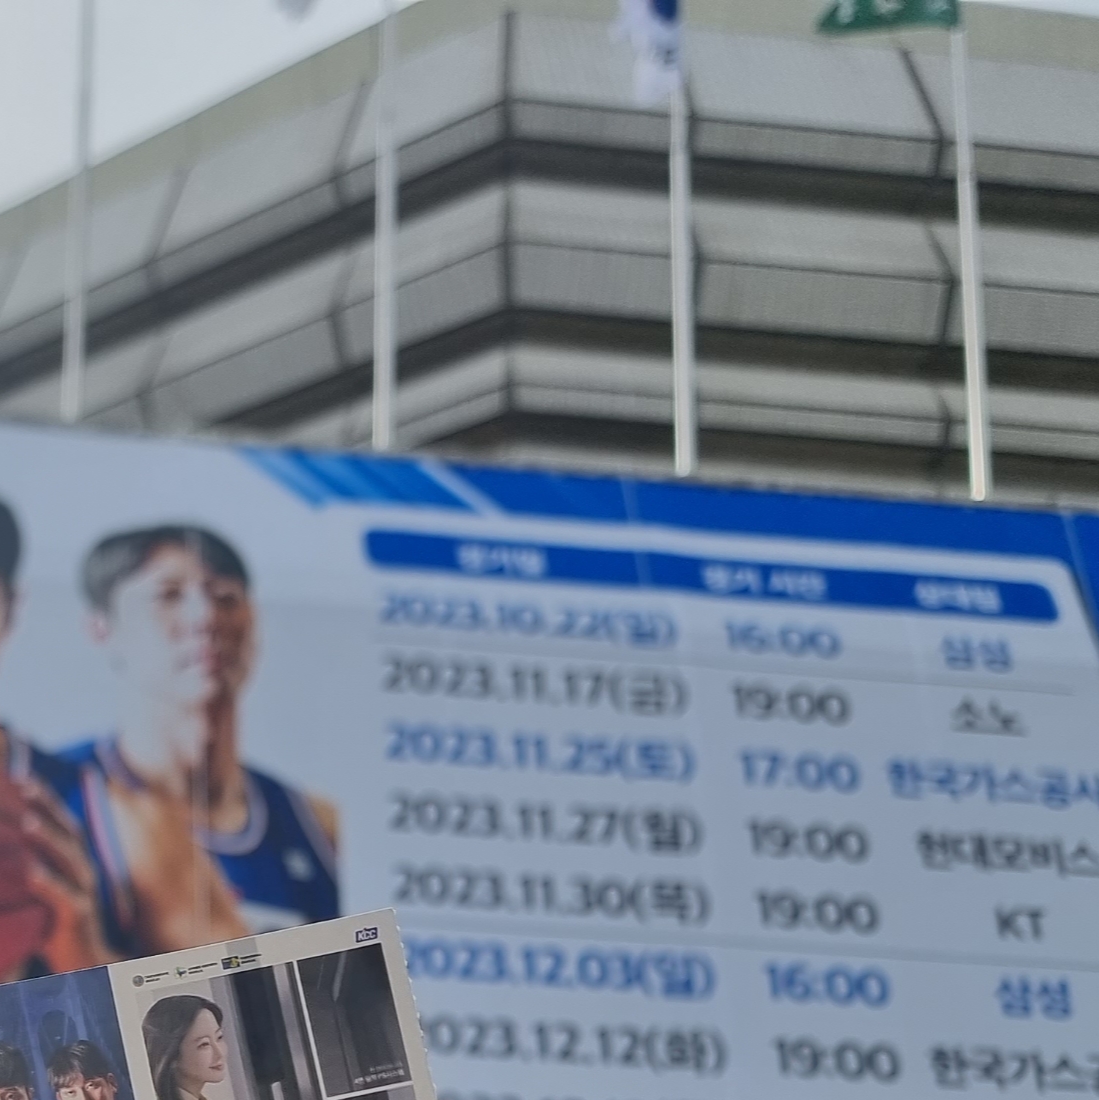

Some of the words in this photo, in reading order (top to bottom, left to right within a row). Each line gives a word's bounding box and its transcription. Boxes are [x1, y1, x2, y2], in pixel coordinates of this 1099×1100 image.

[725, 620, 842, 660] 16:00
[382, 653, 688, 713] 2023.11.17(금)
[733, 681, 850, 727] 19:00
[387, 722, 697, 784] 2023.11.25(토)
[742, 748, 861, 794] 17:00
[389, 795, 703, 857] 2023.11.27(월)
[749, 817, 869, 864] 19:00
[394, 864, 712, 926] 2023.11.30(목)
[757, 888, 880, 935] 19:00
[355, 926, 379, 942] KCC
[996, 905, 1047, 943] KT
[767, 961, 892, 1010] 16:00
[996, 976, 1076, 1021] 삼성
[421, 1014, 727, 1077] 023.12.12(화)
[775, 1036, 902, 1084] 19:00
